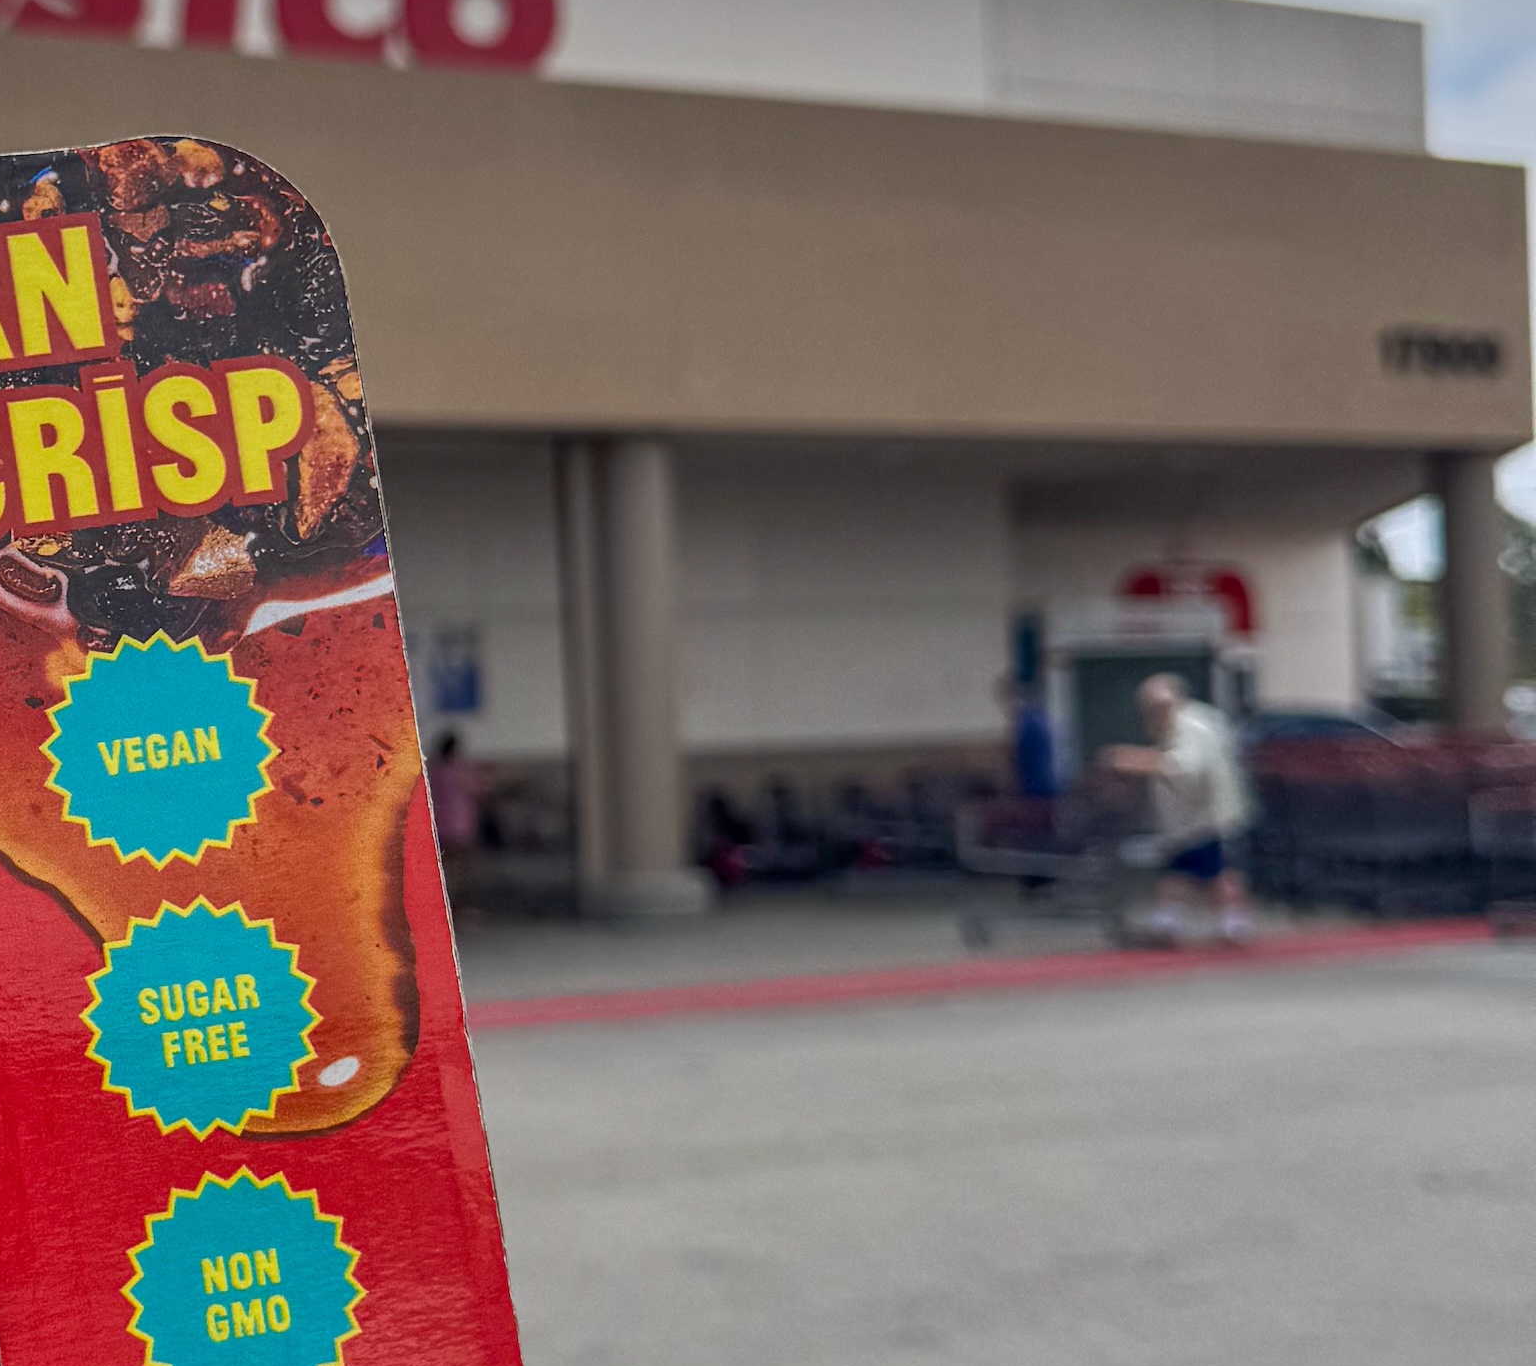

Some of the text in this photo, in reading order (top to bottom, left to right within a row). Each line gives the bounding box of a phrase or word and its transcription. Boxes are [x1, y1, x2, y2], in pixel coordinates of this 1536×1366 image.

[97, 726, 222, 777] VEGAN
[138, 973, 260, 1025] SUGAR
[161, 1021, 250, 1068] FREE
[201, 1247, 281, 1295] NON
[205, 1295, 291, 1342] GMO
